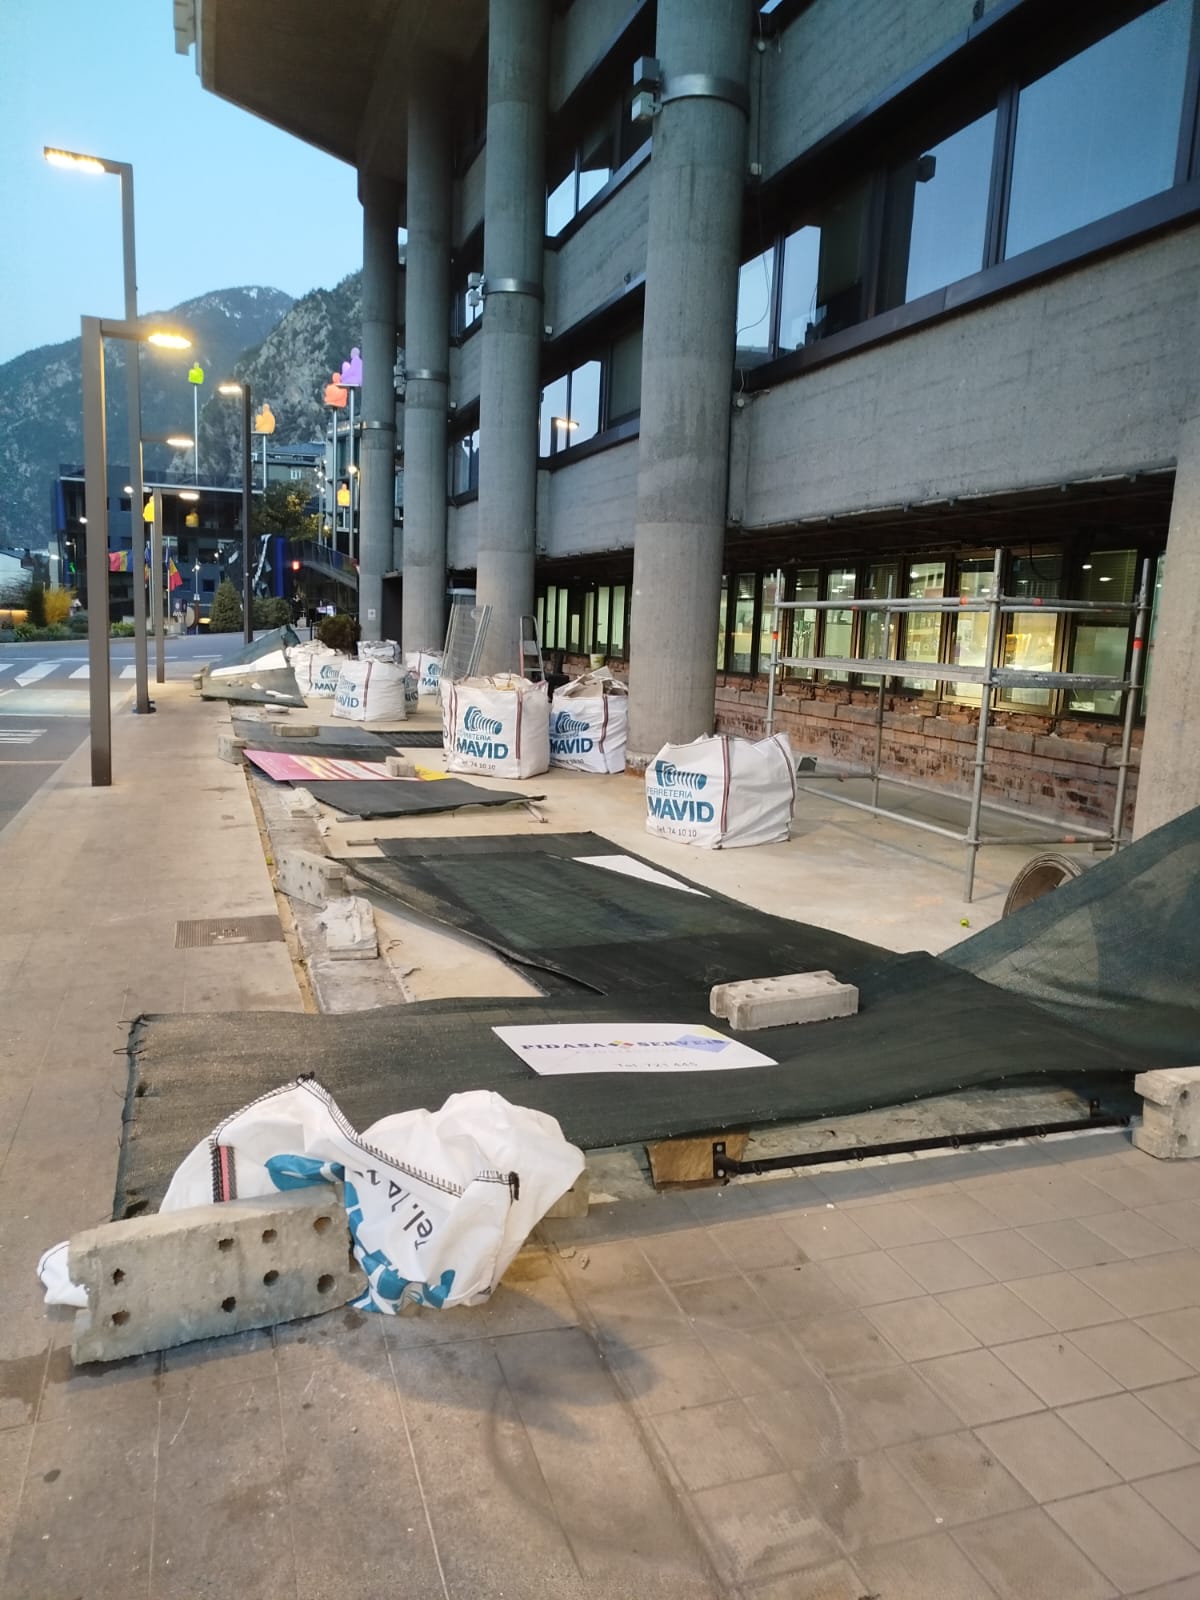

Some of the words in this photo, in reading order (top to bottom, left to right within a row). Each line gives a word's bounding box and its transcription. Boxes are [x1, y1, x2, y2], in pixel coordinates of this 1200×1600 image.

[315, 682, 337, 692] MAV
[457, 738, 509, 760] MAVID
[647, 787, 692, 799] FERRETERIA
[647, 796, 714, 823] MAVID
[678, 829, 687, 837] 10
[637, 1039, 727, 1047] SERVEIS
